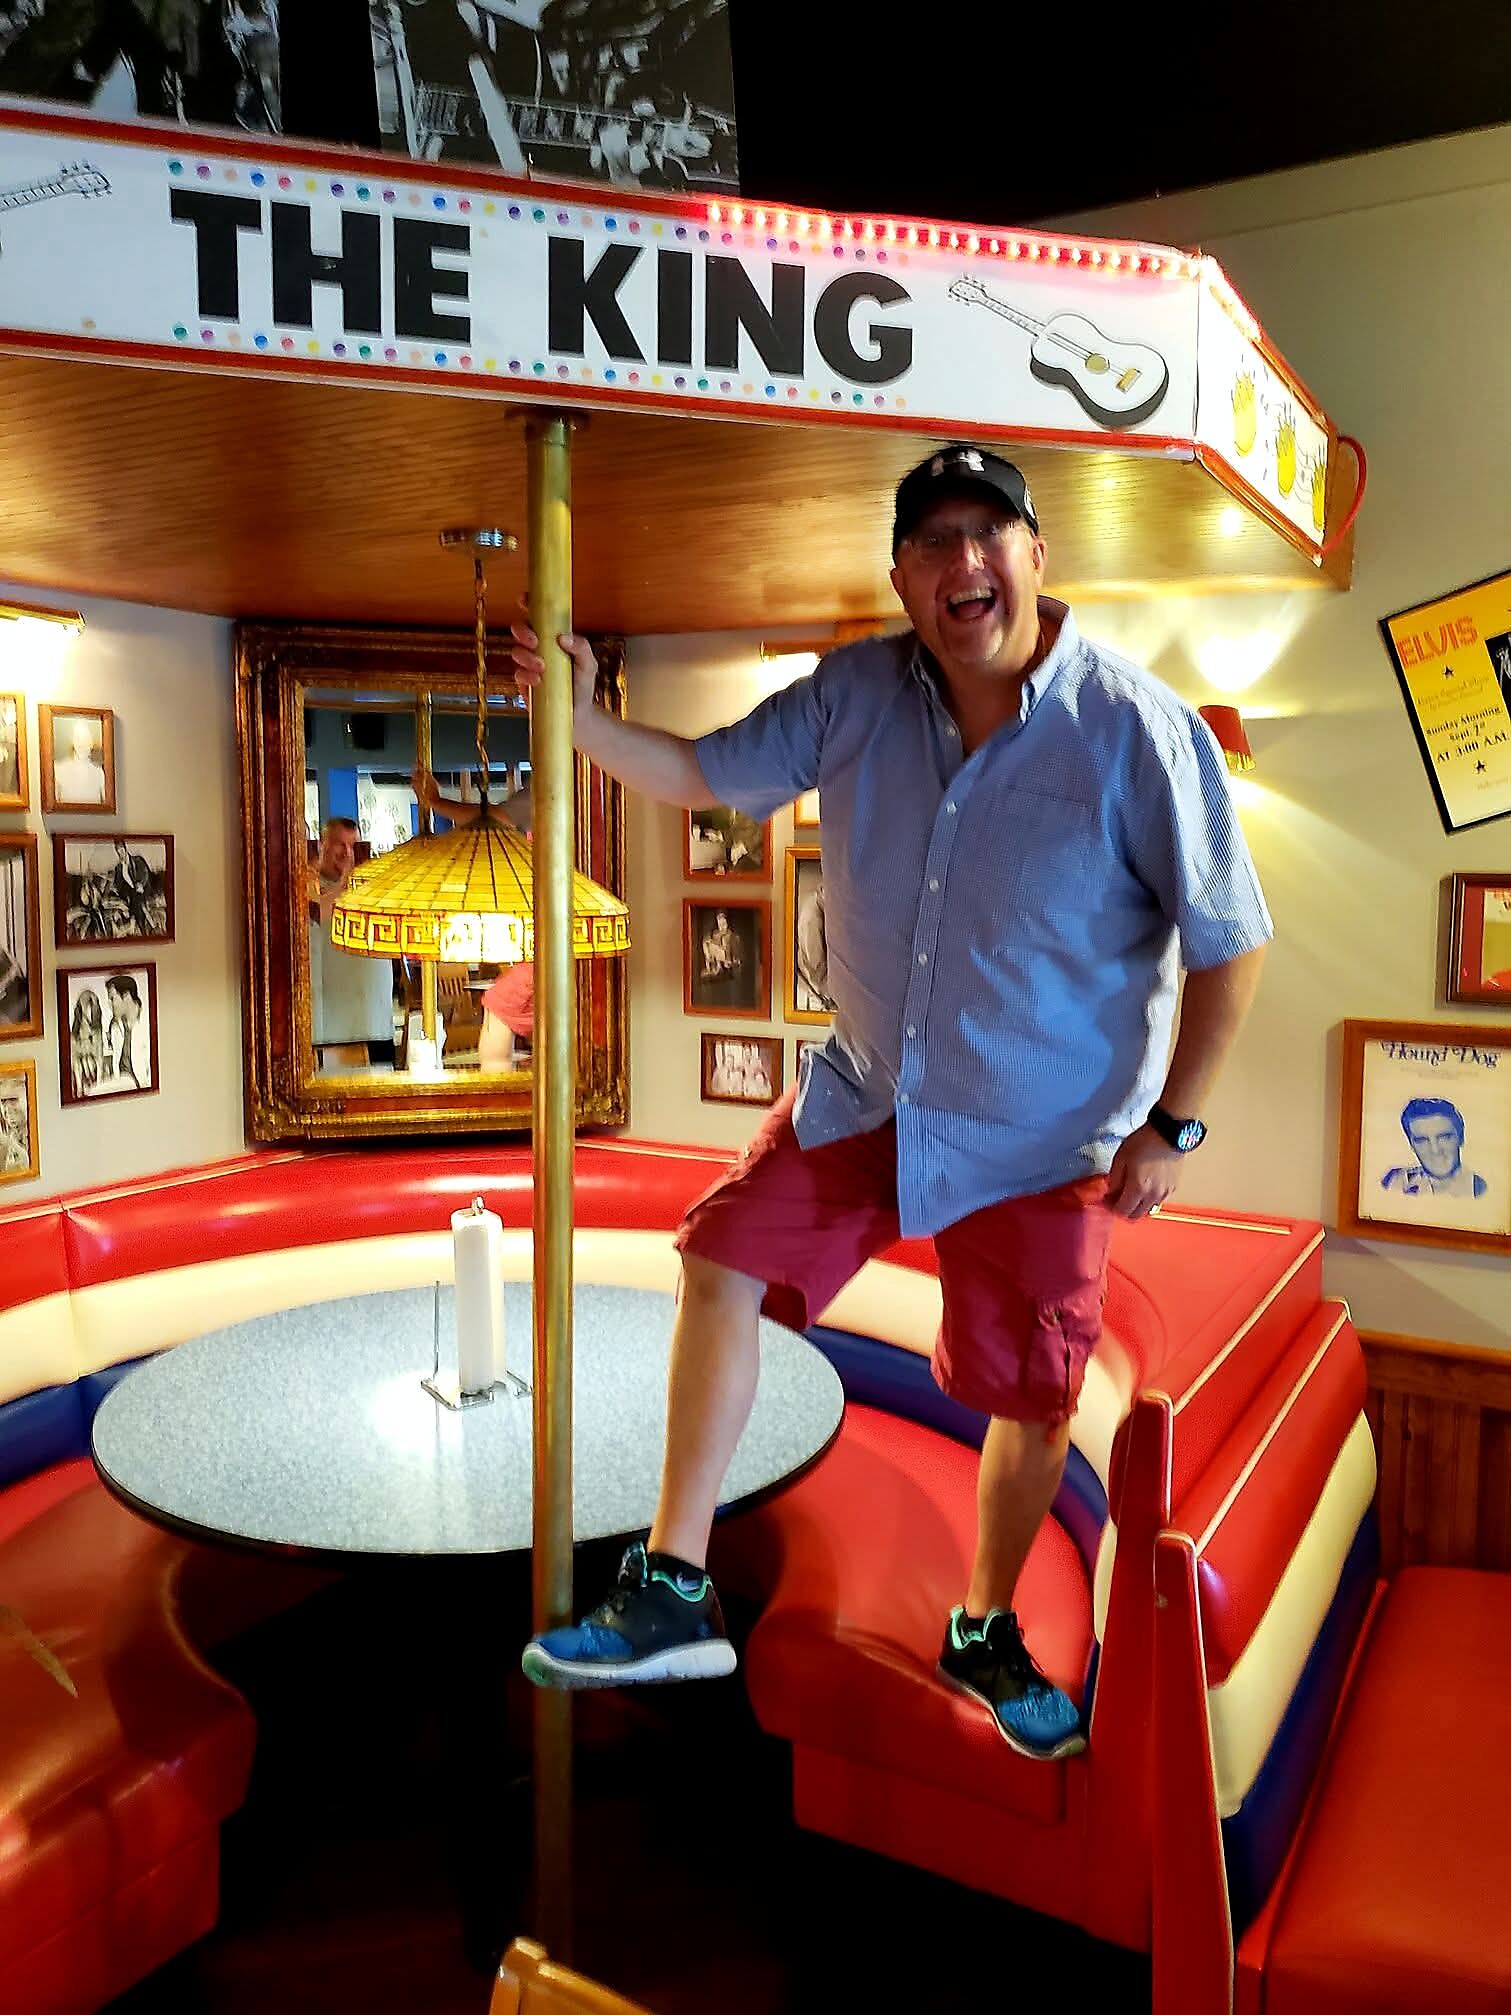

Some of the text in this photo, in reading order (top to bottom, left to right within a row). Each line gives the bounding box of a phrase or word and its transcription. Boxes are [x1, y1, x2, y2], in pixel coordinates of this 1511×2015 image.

[170, 187, 913, 384] THE KING
[1397, 616, 1478, 667] ELVIS
